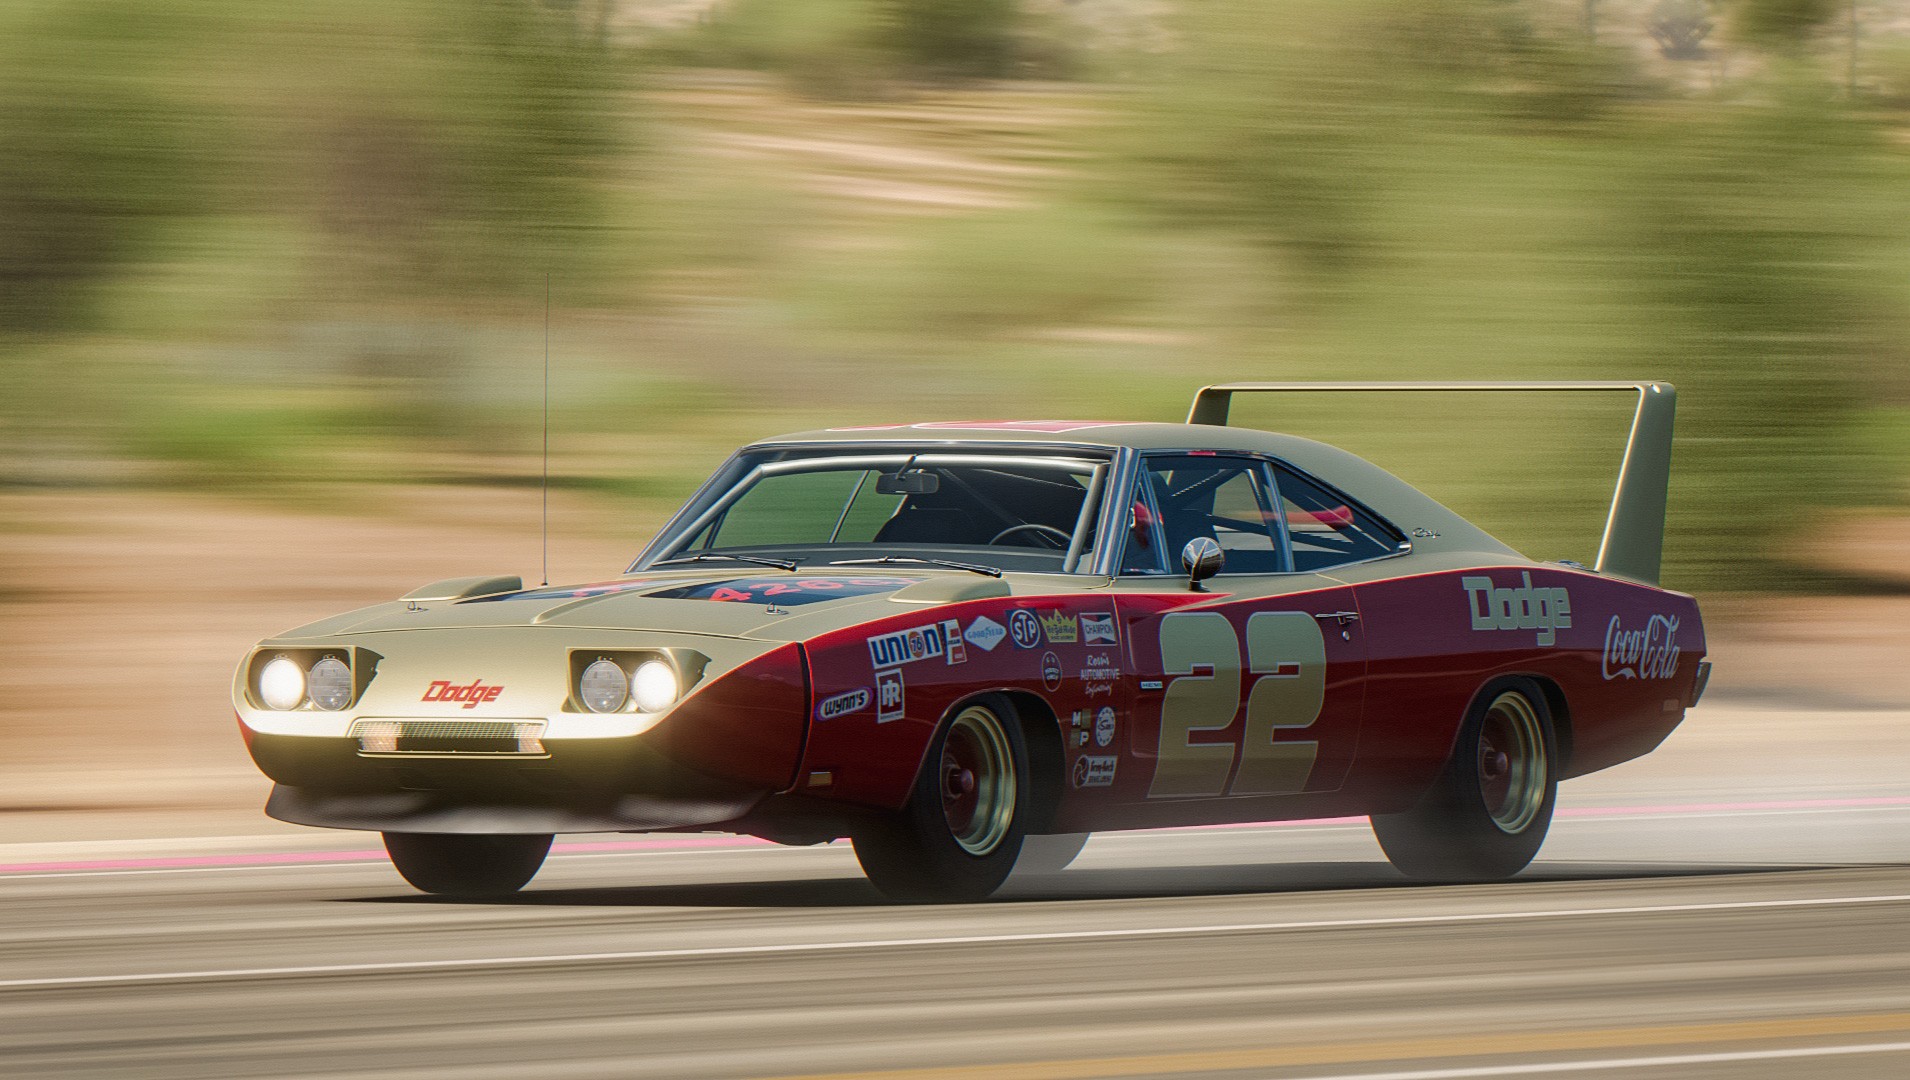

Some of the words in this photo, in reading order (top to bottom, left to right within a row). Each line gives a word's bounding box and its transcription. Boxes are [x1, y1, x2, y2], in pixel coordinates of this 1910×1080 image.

[1014, 613, 1037, 643] STP
[1461, 570, 1572, 647] Dodge
[1602, 613, 1680, 681] Coca-Cola
[420, 678, 505, 709] Dodge
[1146, 611, 1327, 799] 22
